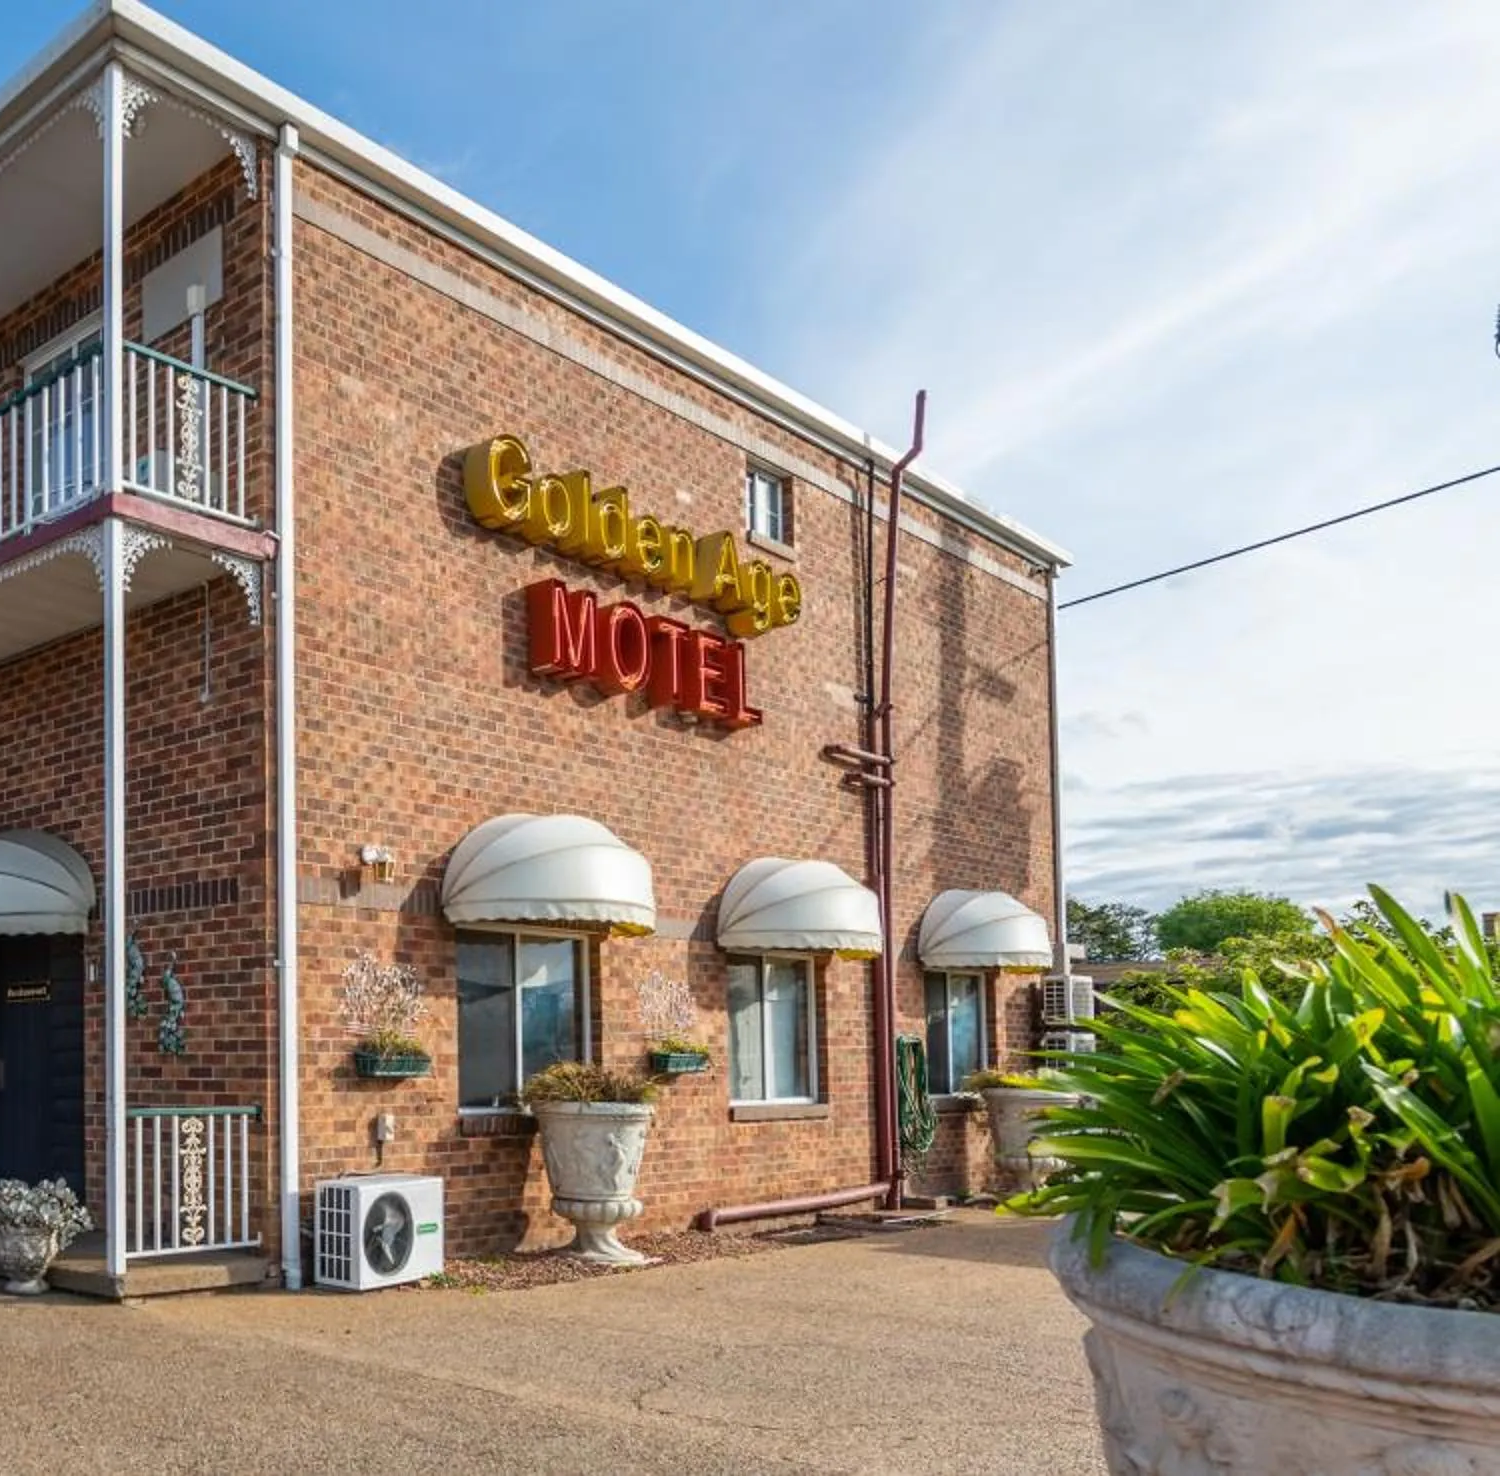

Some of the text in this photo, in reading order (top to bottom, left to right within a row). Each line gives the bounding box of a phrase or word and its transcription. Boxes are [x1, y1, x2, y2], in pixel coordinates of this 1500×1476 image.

[464, 432, 802, 638] Golden Age
[526, 577, 763, 728] MOTEL
